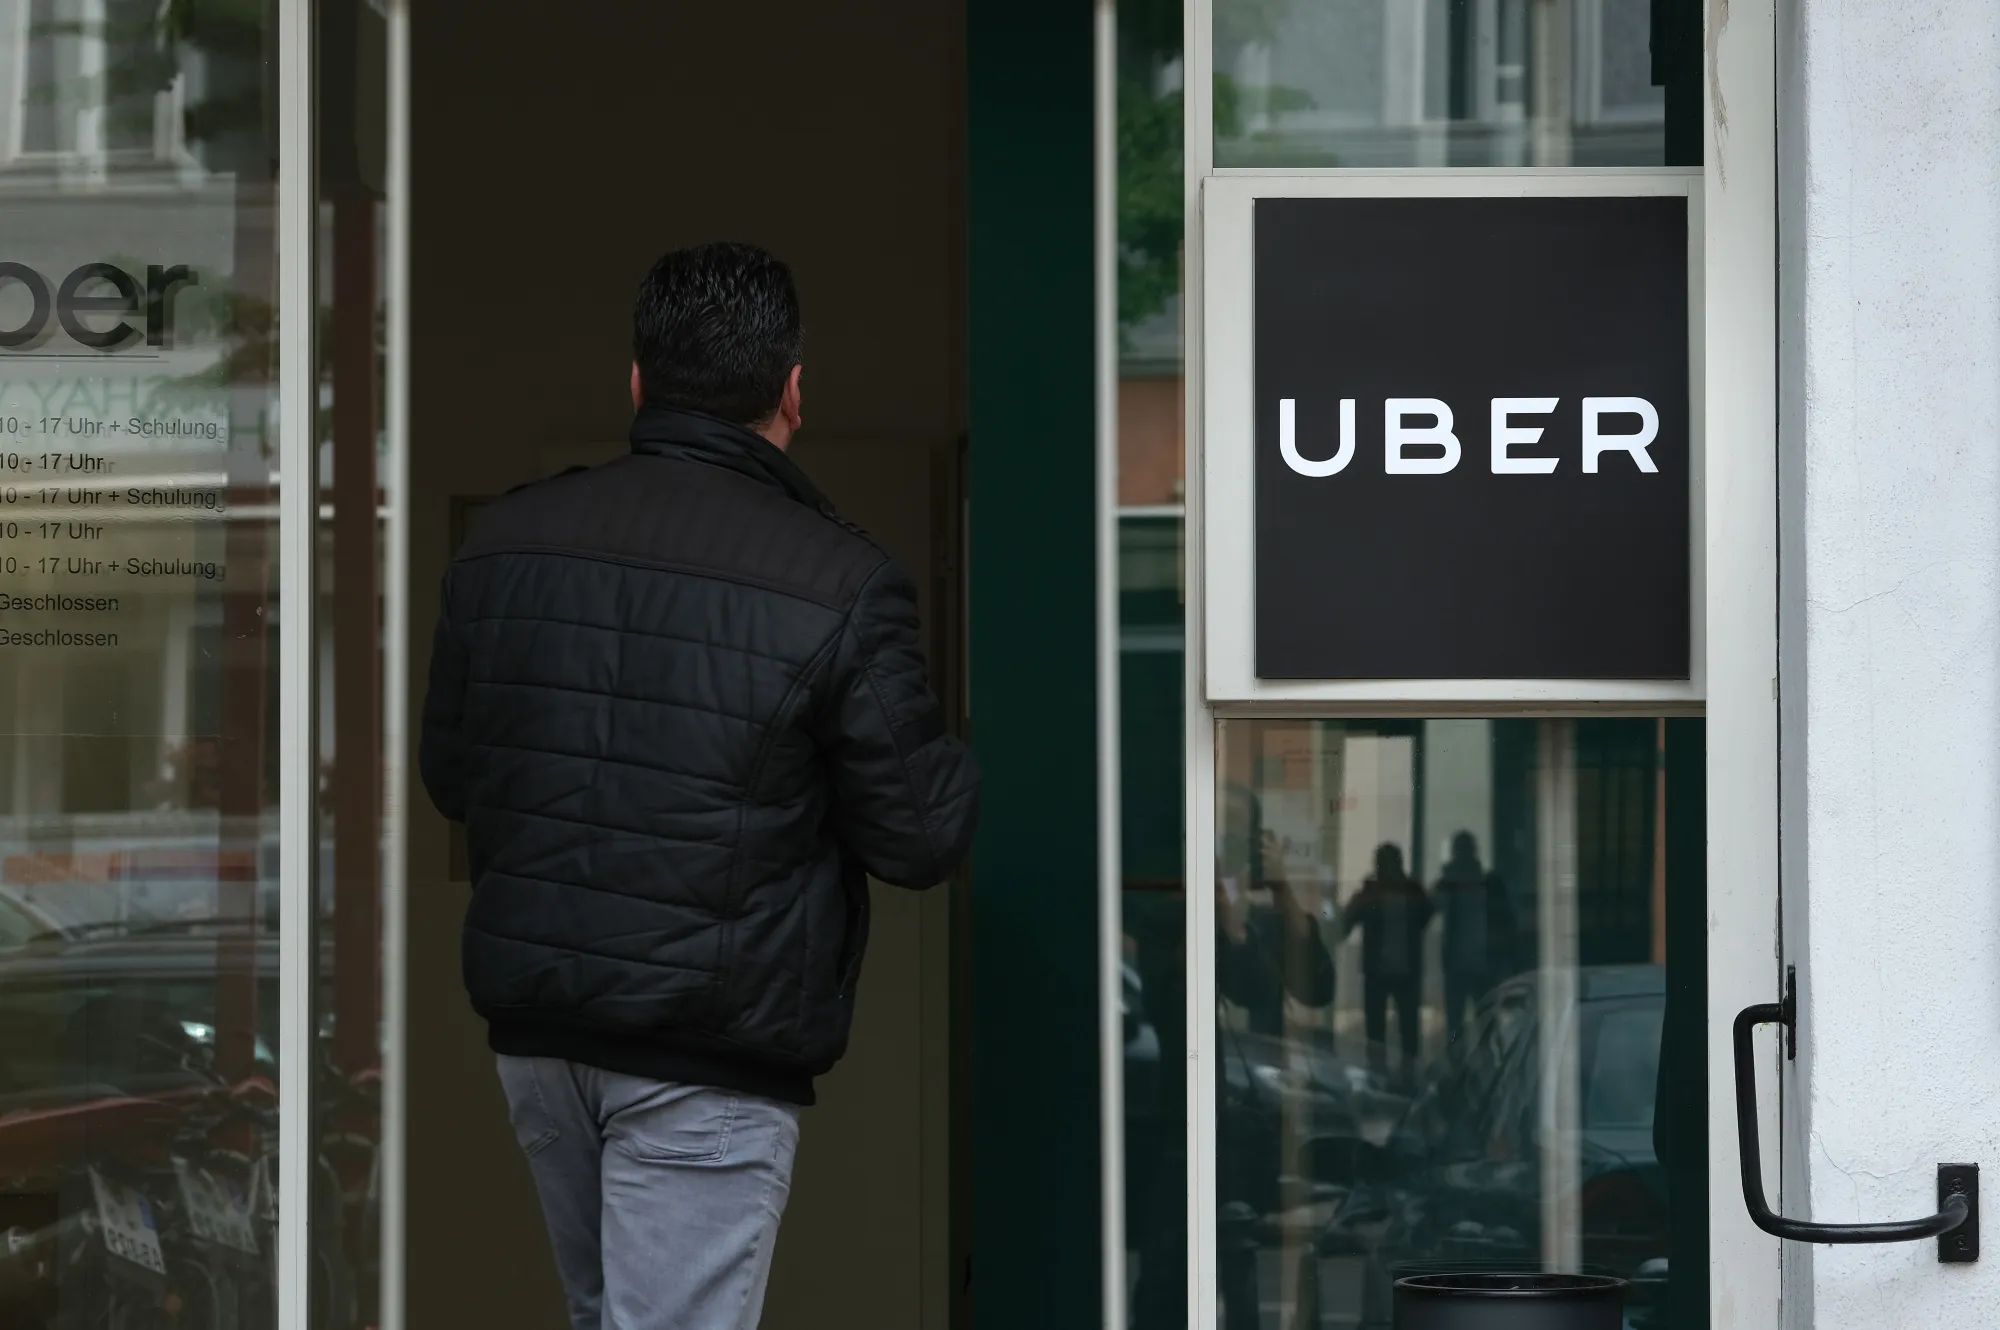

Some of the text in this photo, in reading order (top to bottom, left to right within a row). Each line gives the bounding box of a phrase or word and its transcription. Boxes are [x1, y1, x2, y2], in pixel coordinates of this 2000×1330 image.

[0, 417, 18, 434] 10
[40, 417, 62, 434] 17
[69, 418, 103, 435] Uhr
[110, 421, 121, 432] +
[128, 418, 217, 440] Schulung
[1280, 397, 1659, 477] UBER
[0, 453, 19, 470] 10
[40, 453, 62, 470] 17
[69, 454, 104, 470] Uhr
[40, 487, 60, 504] 17
[68, 488, 102, 504] Uhr
[109, 491, 120, 502] +
[127, 488, 216, 509] Schulung
[0, 522, 18, 539] 10
[40, 522, 61, 539] 17
[69, 523, 103, 539] Uhr
[38, 557, 60, 574] 17
[68, 557, 102, 574] Uhr
[108, 561, 120, 573] +
[127, 557, 216, 580] Schulung
[0, 593, 119, 611] Geschlossen
[0, 629, 118, 647] Geschlossen
